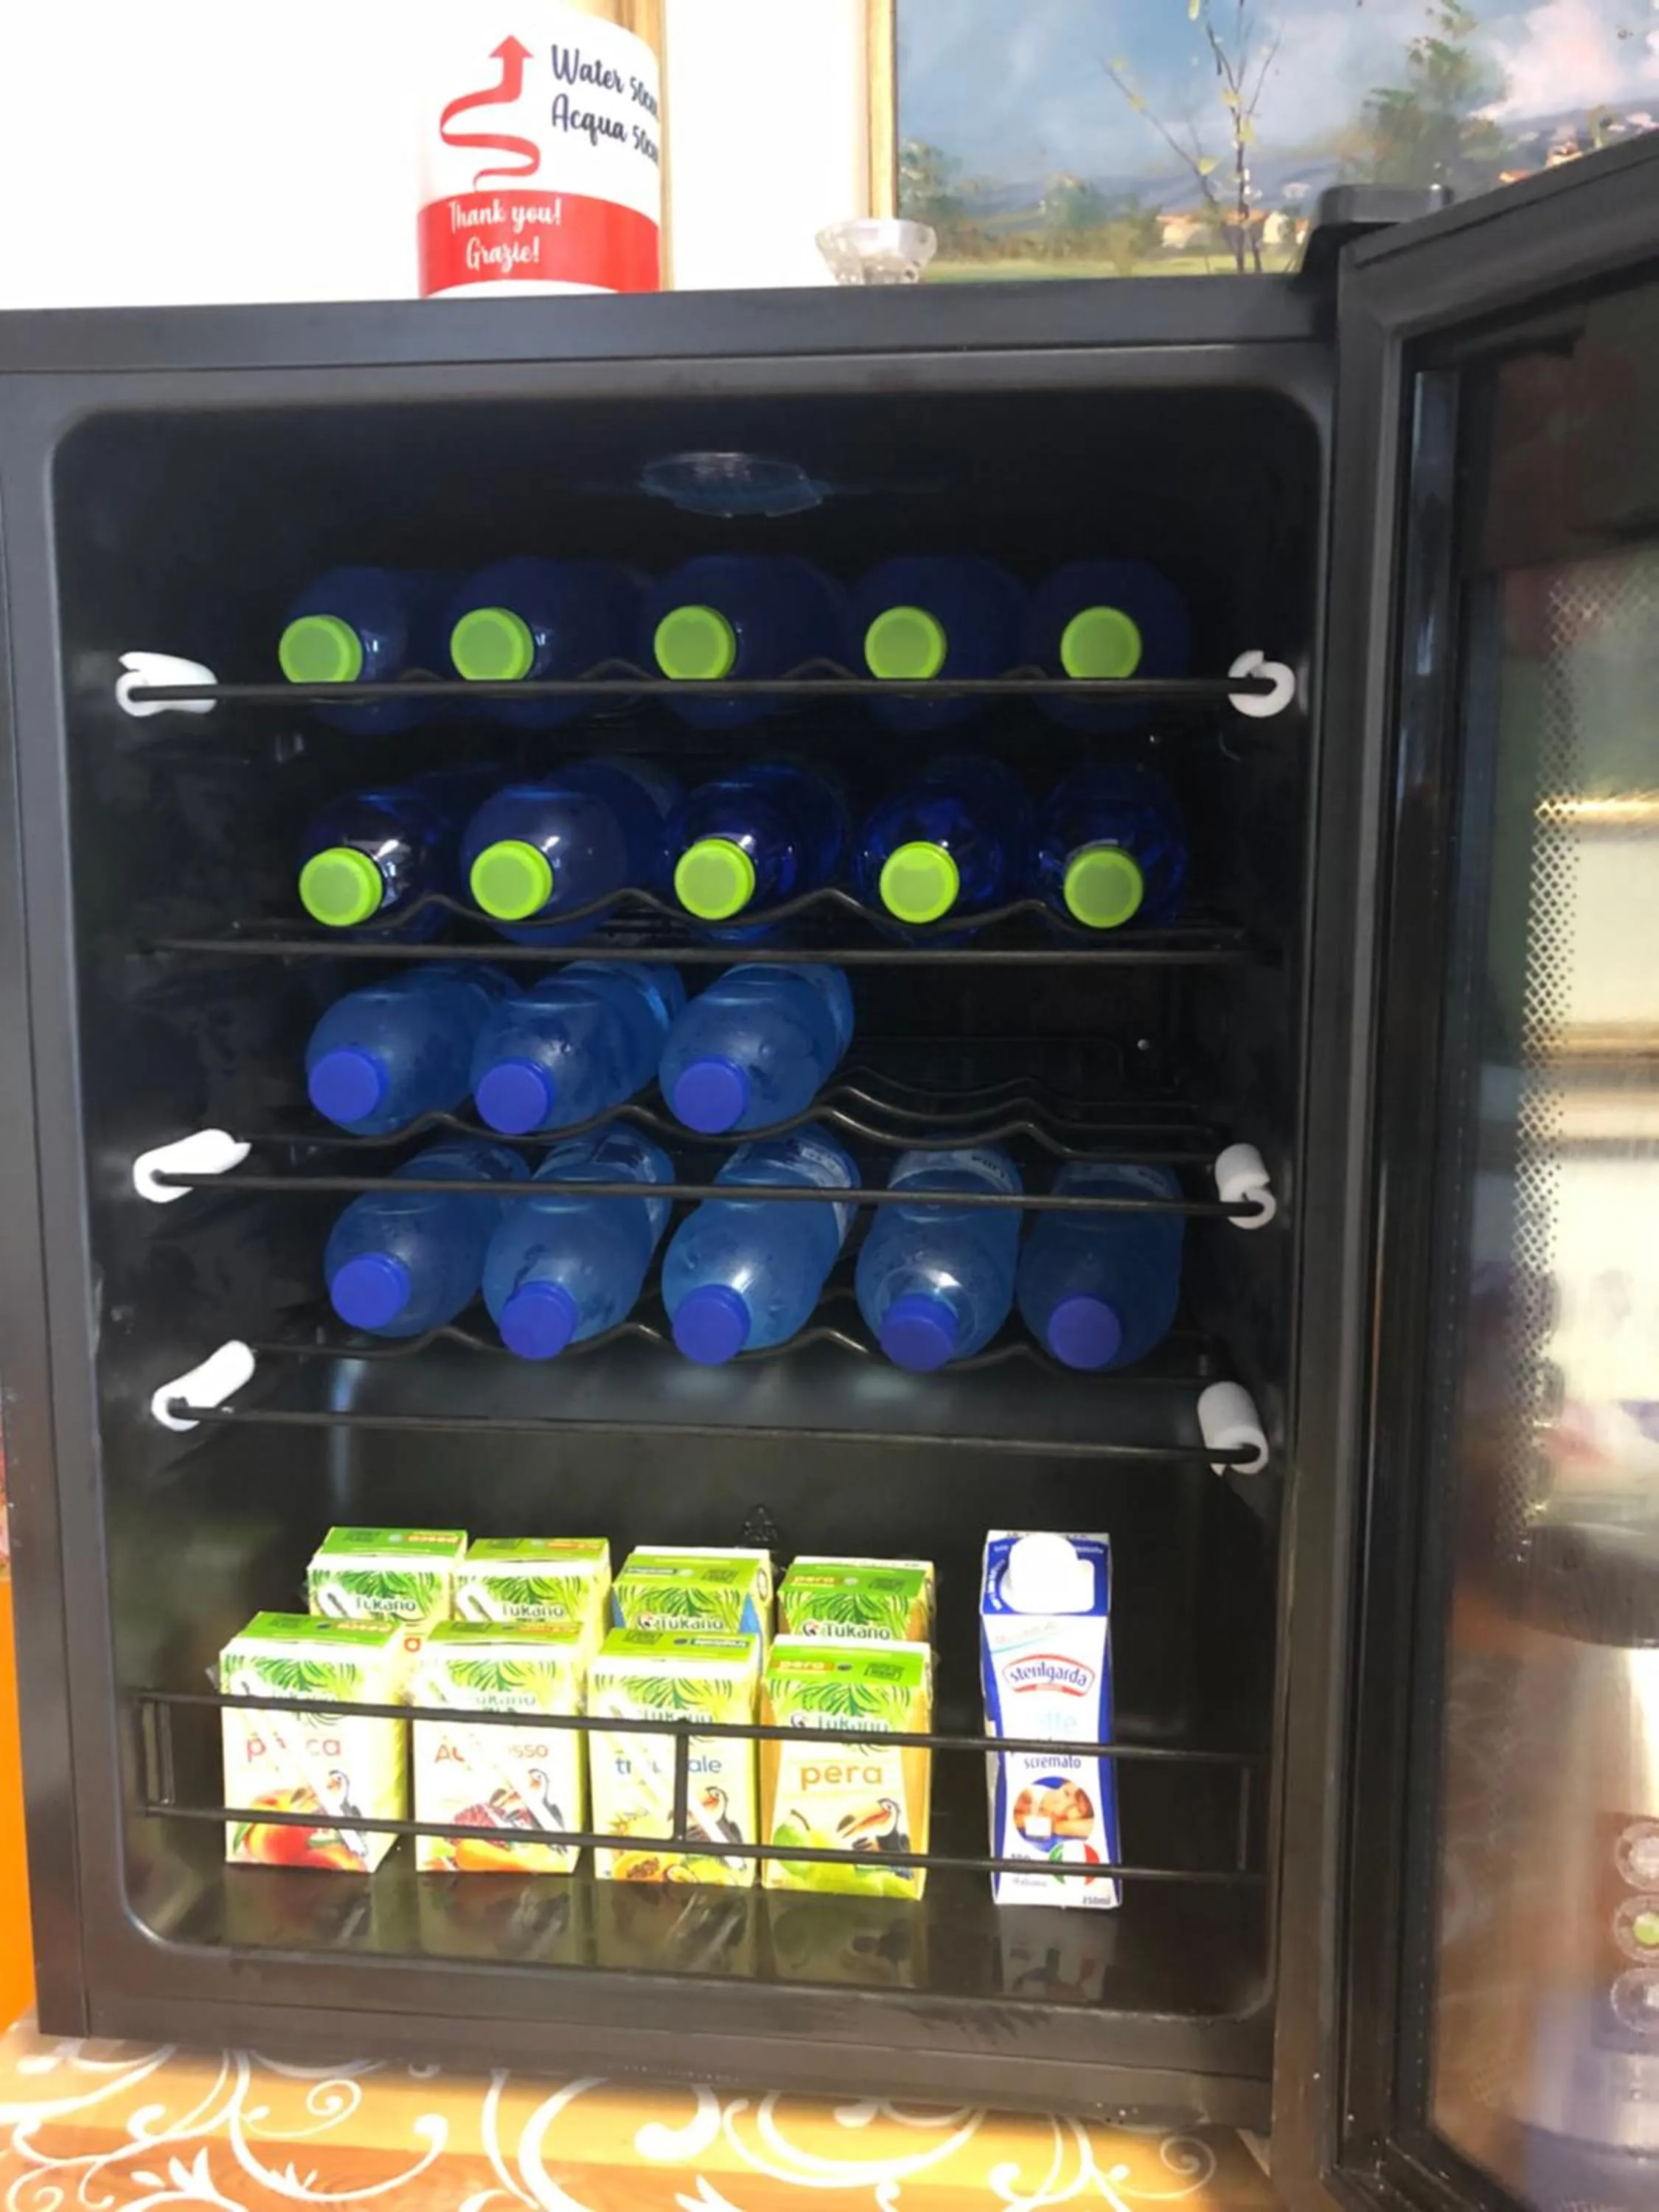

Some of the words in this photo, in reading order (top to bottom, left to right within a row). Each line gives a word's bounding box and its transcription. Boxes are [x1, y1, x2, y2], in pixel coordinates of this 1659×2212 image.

[552, 44, 625, 94] Water
[552, 93, 627, 147] Acqua
[448, 198, 507, 234] Thank
[512, 198, 562, 234] you!
[467, 235, 540, 274] Grazie!
[355, 1596, 417, 1613] Tukano
[501, 1604, 566, 1618] Tukano
[659, 1615, 724, 1630] Tukano
[824, 1623, 891, 1641] Tukano
[1023, 1752, 1082, 1769] scremato
[801, 1765, 883, 1792] pera
